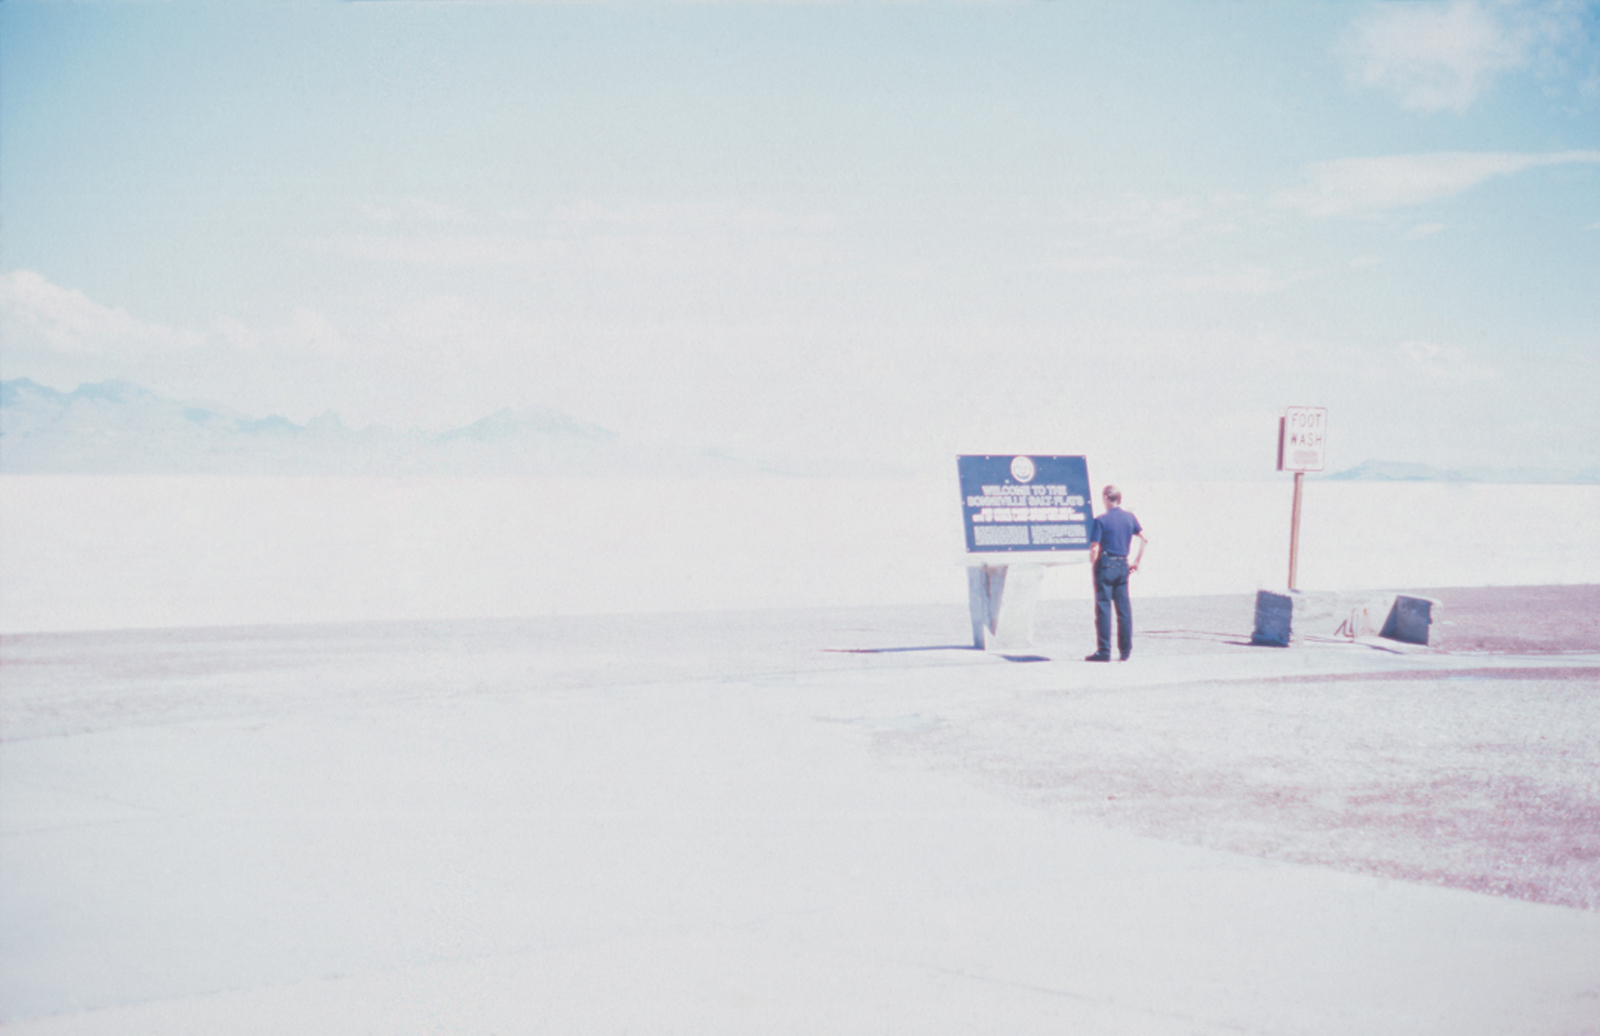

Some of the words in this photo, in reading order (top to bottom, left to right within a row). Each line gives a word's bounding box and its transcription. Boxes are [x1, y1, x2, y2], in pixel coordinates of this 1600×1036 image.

[1291, 413, 1321, 427] FOOT
[1290, 432, 1322, 447] WASH
[981, 484, 1030, 496] WELCOME
[1031, 484, 1046, 496] TO
[1046, 484, 1067, 496] THE
